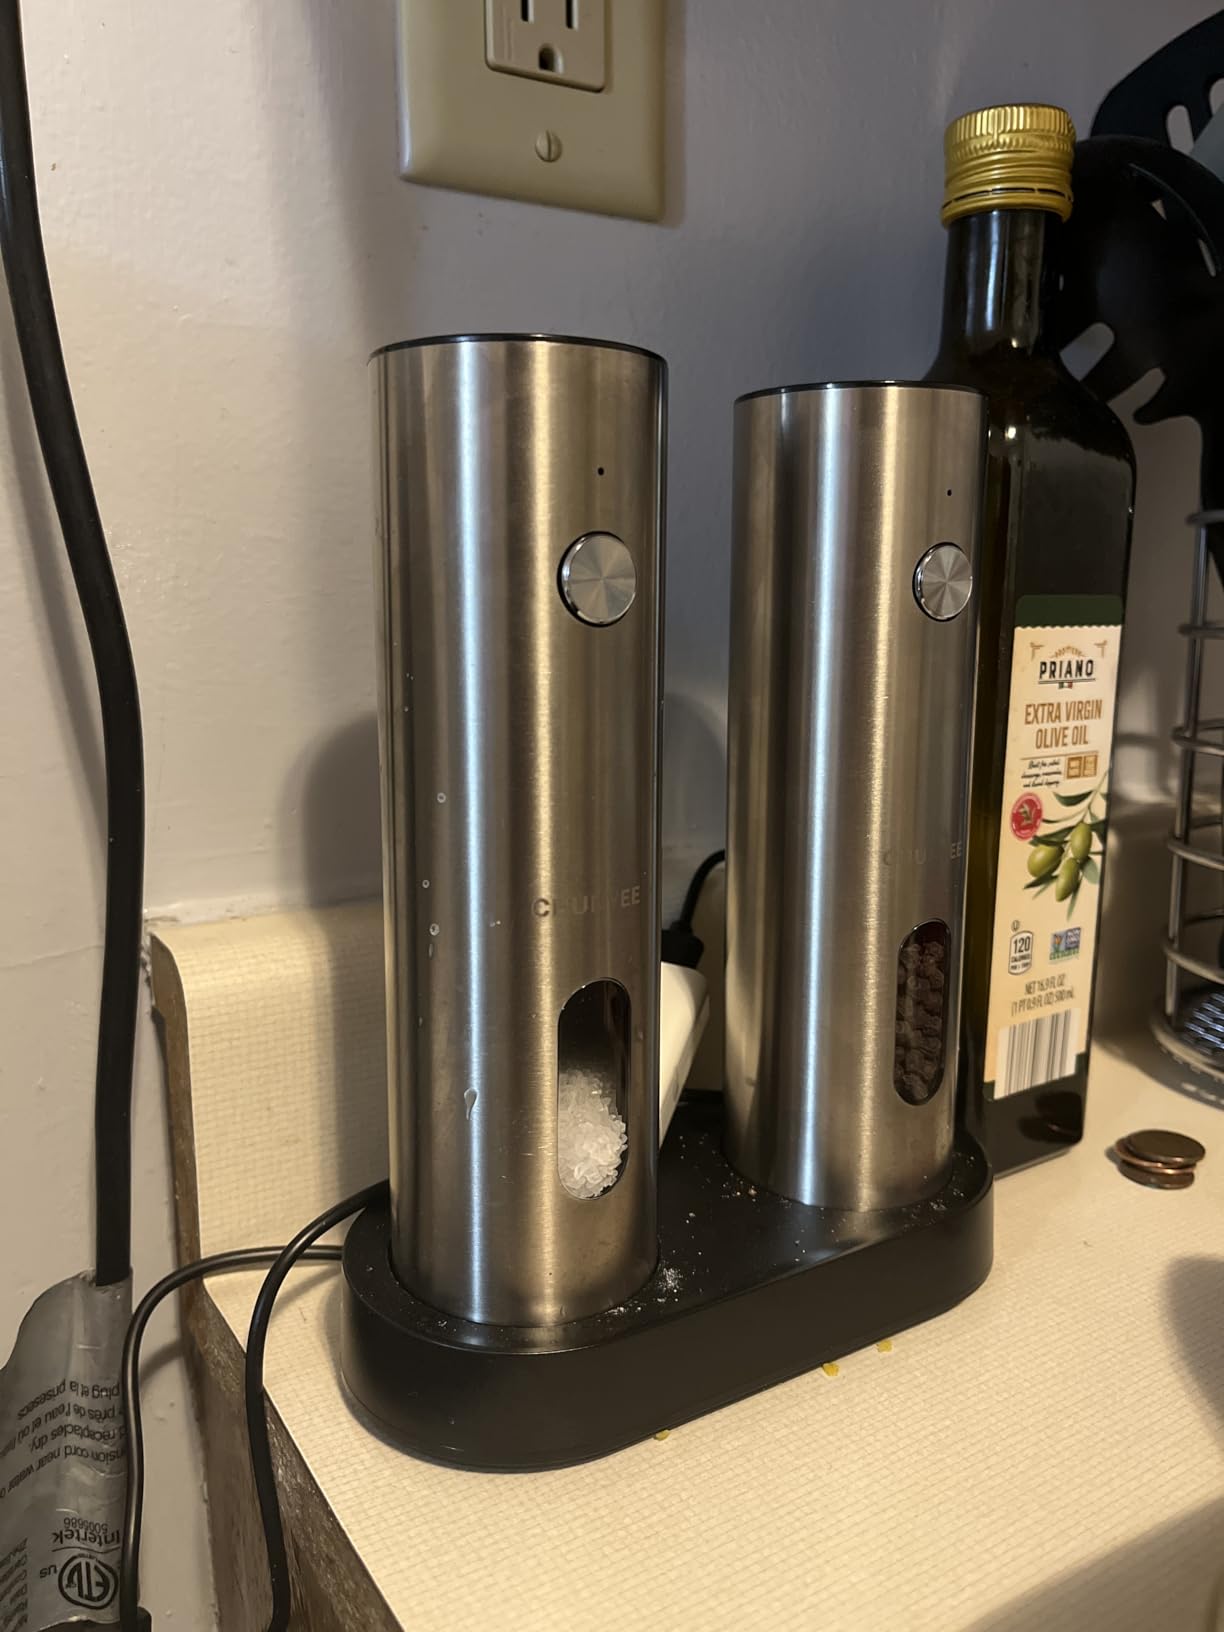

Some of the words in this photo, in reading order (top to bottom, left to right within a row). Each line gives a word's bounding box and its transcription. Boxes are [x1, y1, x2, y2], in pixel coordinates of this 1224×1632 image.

[1039, 659, 1095, 679] PRIANO
[1024, 702, 1062, 725] EXTRA
[1065, 699, 1103, 722] VIRGIN
[1035, 726, 1068, 750] OLIVE
[1072, 725, 1089, 745] OIL
[1013, 936, 1031, 955] 120
[1025, 981, 1037, 995] NET
[69, 1380, 79, 1397] la
[80, 1384, 89, 1397] et
[91, 1382, 120, 1400] plug
[72, 1403, 86, 1418] de
[31, 1416, 42, 1433] et
[50, 1423, 117, 1442] receptacles
[35, 1447, 61, 1471] near
[63, 1444, 89, 1459] cord
[51, 1528, 121, 1547] Intertek
